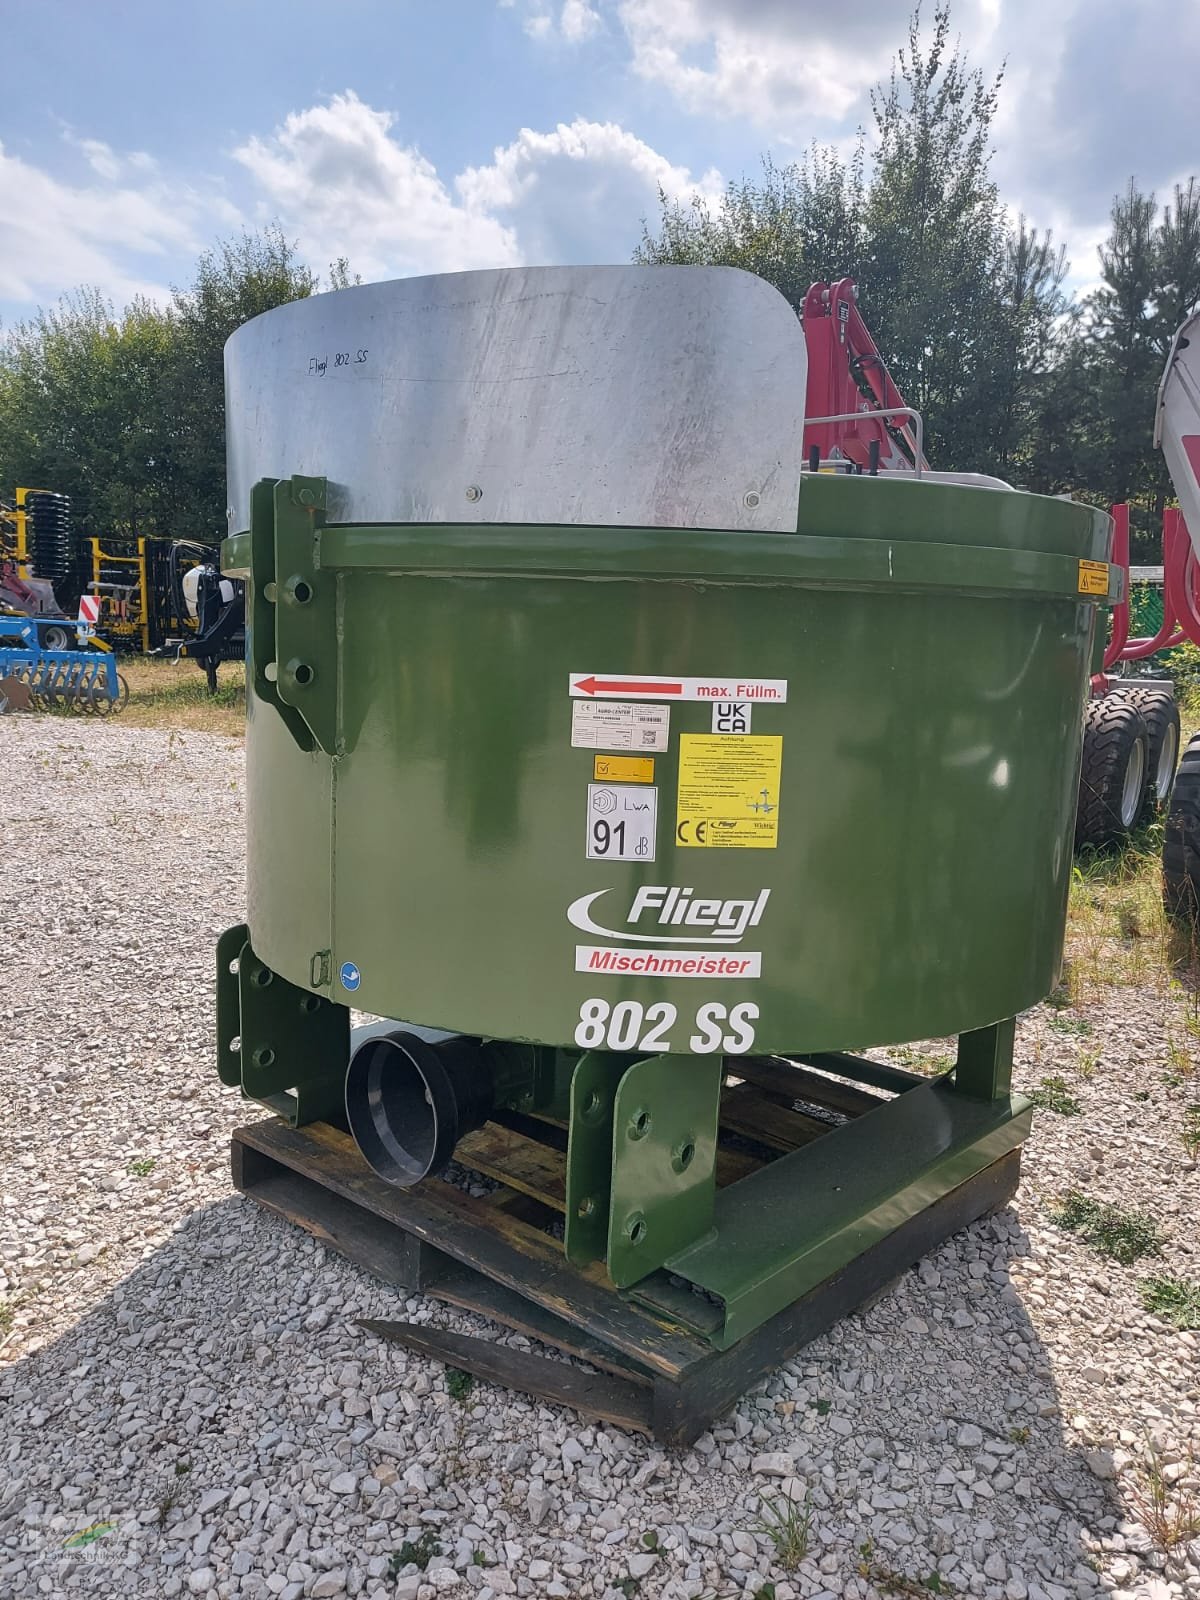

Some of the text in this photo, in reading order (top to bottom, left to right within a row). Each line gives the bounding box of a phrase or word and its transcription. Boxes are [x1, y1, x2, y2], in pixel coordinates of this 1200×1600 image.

[334, 353, 350, 367] 802
[354, 349, 369, 363] SS
[697, 684, 781, 698] max. Füllm.
[718, 703, 745, 718] UK
[717, 718, 746, 733] CA
[593, 819, 626, 856] 91
[635, 836, 649, 856] dB
[627, 886, 772, 936] Fliegl
[589, 951, 751, 974] Mischmeister
[574, 998, 760, 1054] 802 SS
